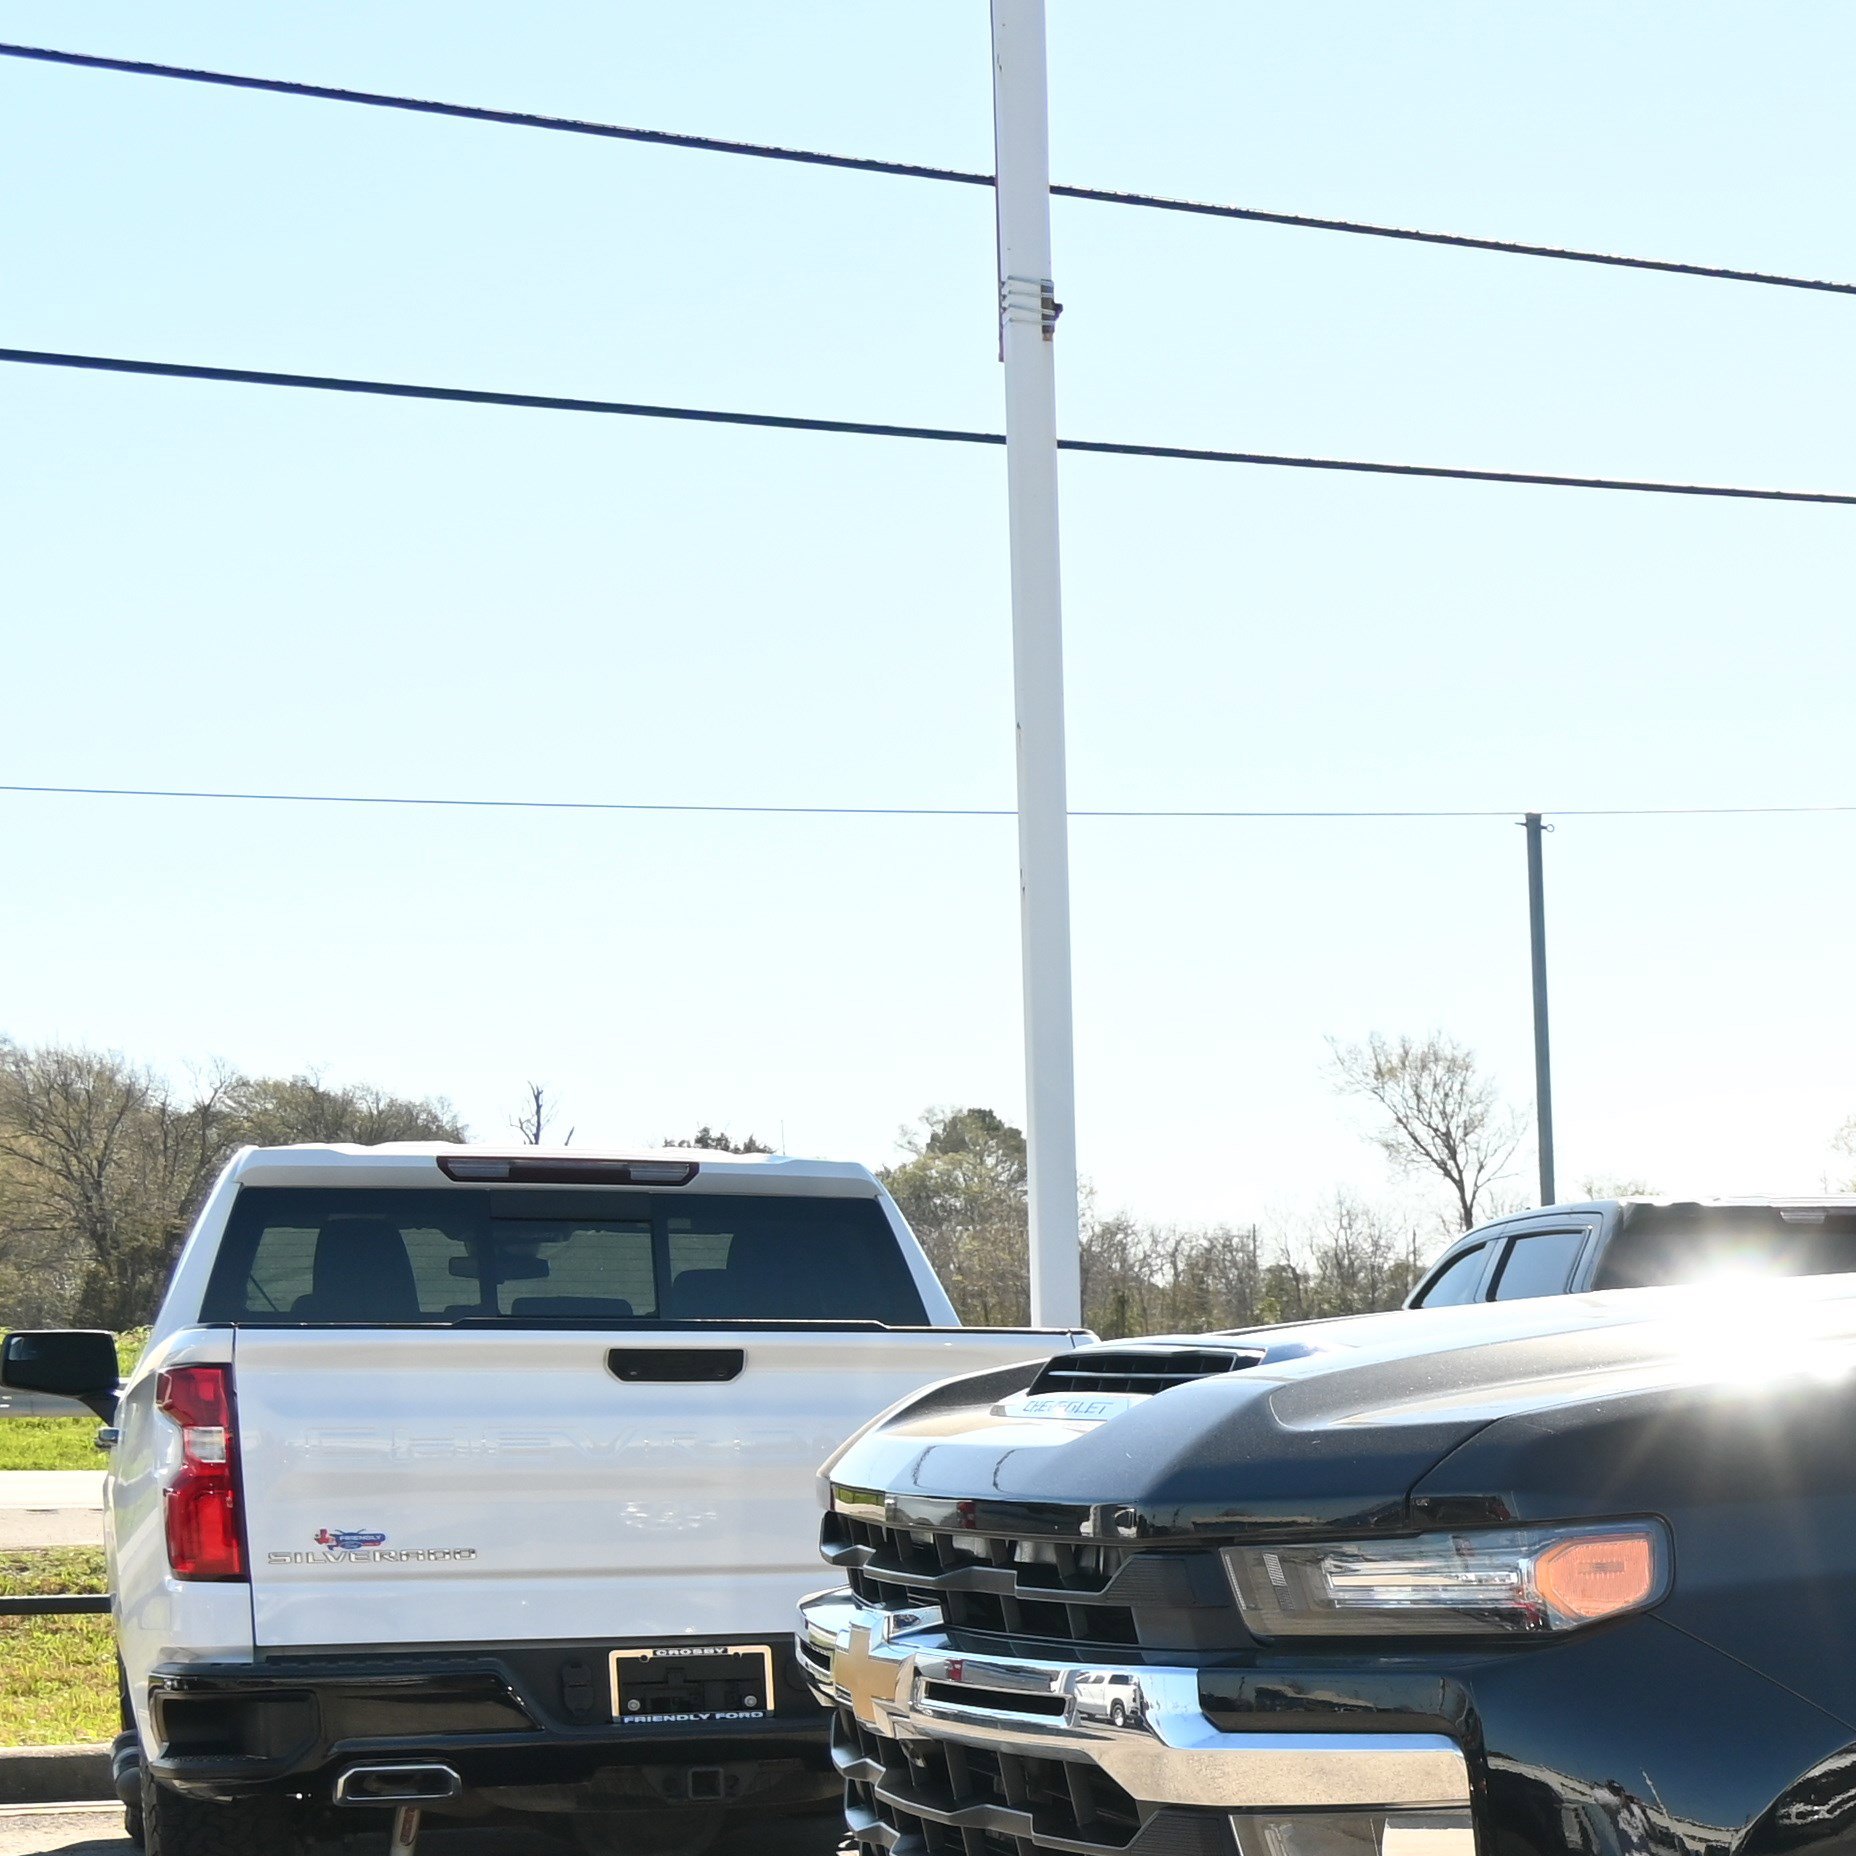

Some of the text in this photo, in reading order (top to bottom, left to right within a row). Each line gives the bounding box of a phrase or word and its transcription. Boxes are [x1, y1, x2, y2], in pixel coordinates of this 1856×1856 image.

[267, 1548, 478, 1565] SILVERADO
[655, 1647, 726, 1656] CROSBY
[623, 1711, 764, 1724] FRIENDLY FORD
